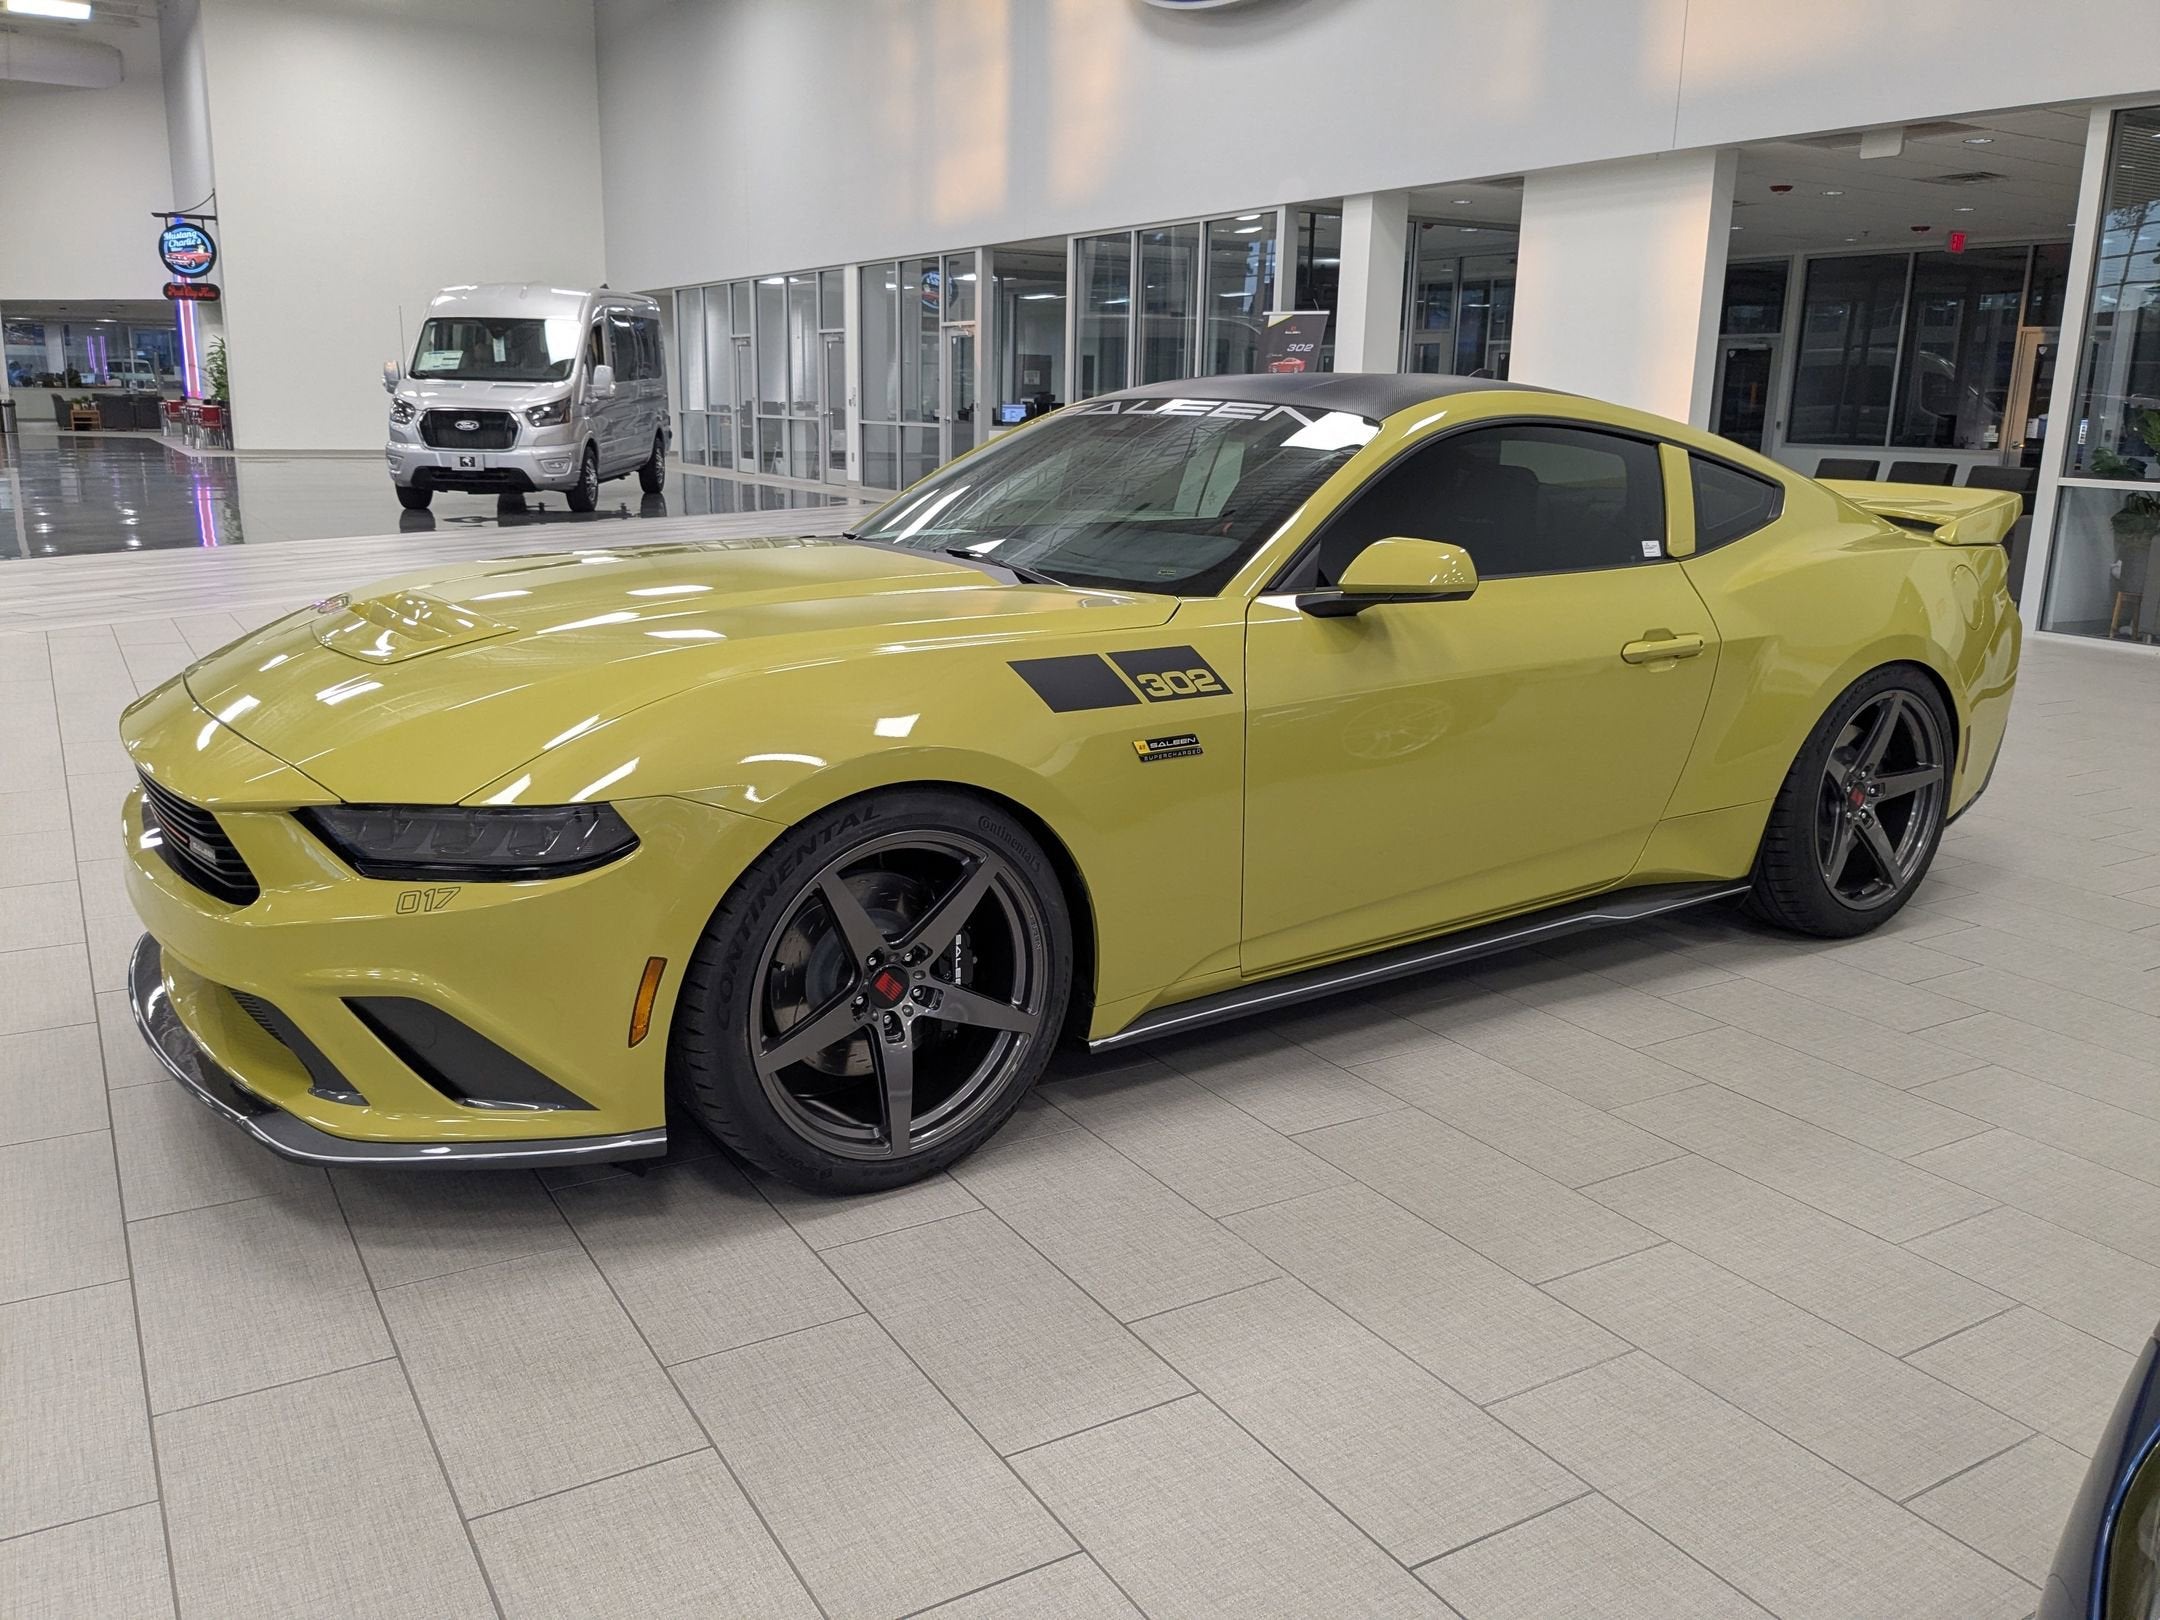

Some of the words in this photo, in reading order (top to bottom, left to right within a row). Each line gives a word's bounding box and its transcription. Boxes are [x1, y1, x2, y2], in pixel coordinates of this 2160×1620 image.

[163, 231, 198, 241] Mustang
[168, 237, 202, 248] Charlie's
[1286, 343, 1314, 352] 302
[1136, 668, 1223, 697] 302
[1150, 736, 1196, 750] SALEEN
[1143, 748, 1201, 762] SUPERCHARGED
[978, 816, 1037, 866] Continental
[396, 886, 461, 914] 017
[715, 806, 881, 1030] CONTINENTAL
[954, 933, 962, 985] SALEE
